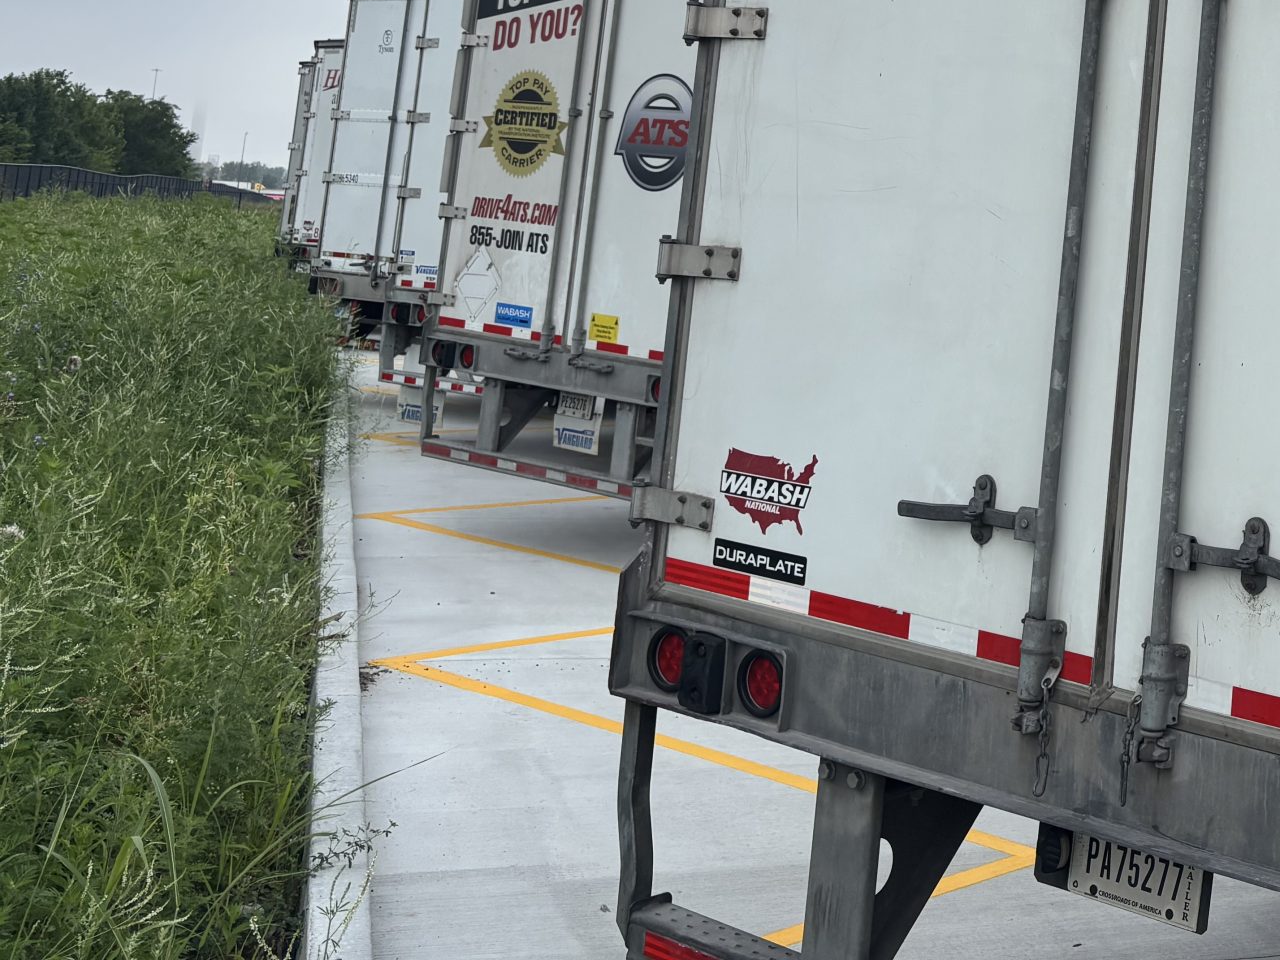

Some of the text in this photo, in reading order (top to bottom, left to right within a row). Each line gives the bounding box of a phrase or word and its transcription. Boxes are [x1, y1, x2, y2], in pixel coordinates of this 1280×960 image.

[493, 4, 583, 51] DO YOU?
[509, 78, 551, 96] TOP PAY
[494, 109, 558, 130] CERTIFIED
[627, 117, 690, 147] ATS
[501, 146, 544, 168] CARRIER
[471, 194, 559, 226] DRIVE4ATS.COM
[469, 225, 549, 254] 855-JOIN ATS
[498, 305, 530, 318] WABASH
[555, 428, 594, 449] VANGUARD
[721, 472, 810, 507] WABASH
[745, 500, 781, 514] NATIONAL
[715, 545, 804, 577] DURAPLATE
[1086, 836, 1184, 901] PA75277
[1098, 890, 1162, 916] CROSSROADS OF AMERICA
